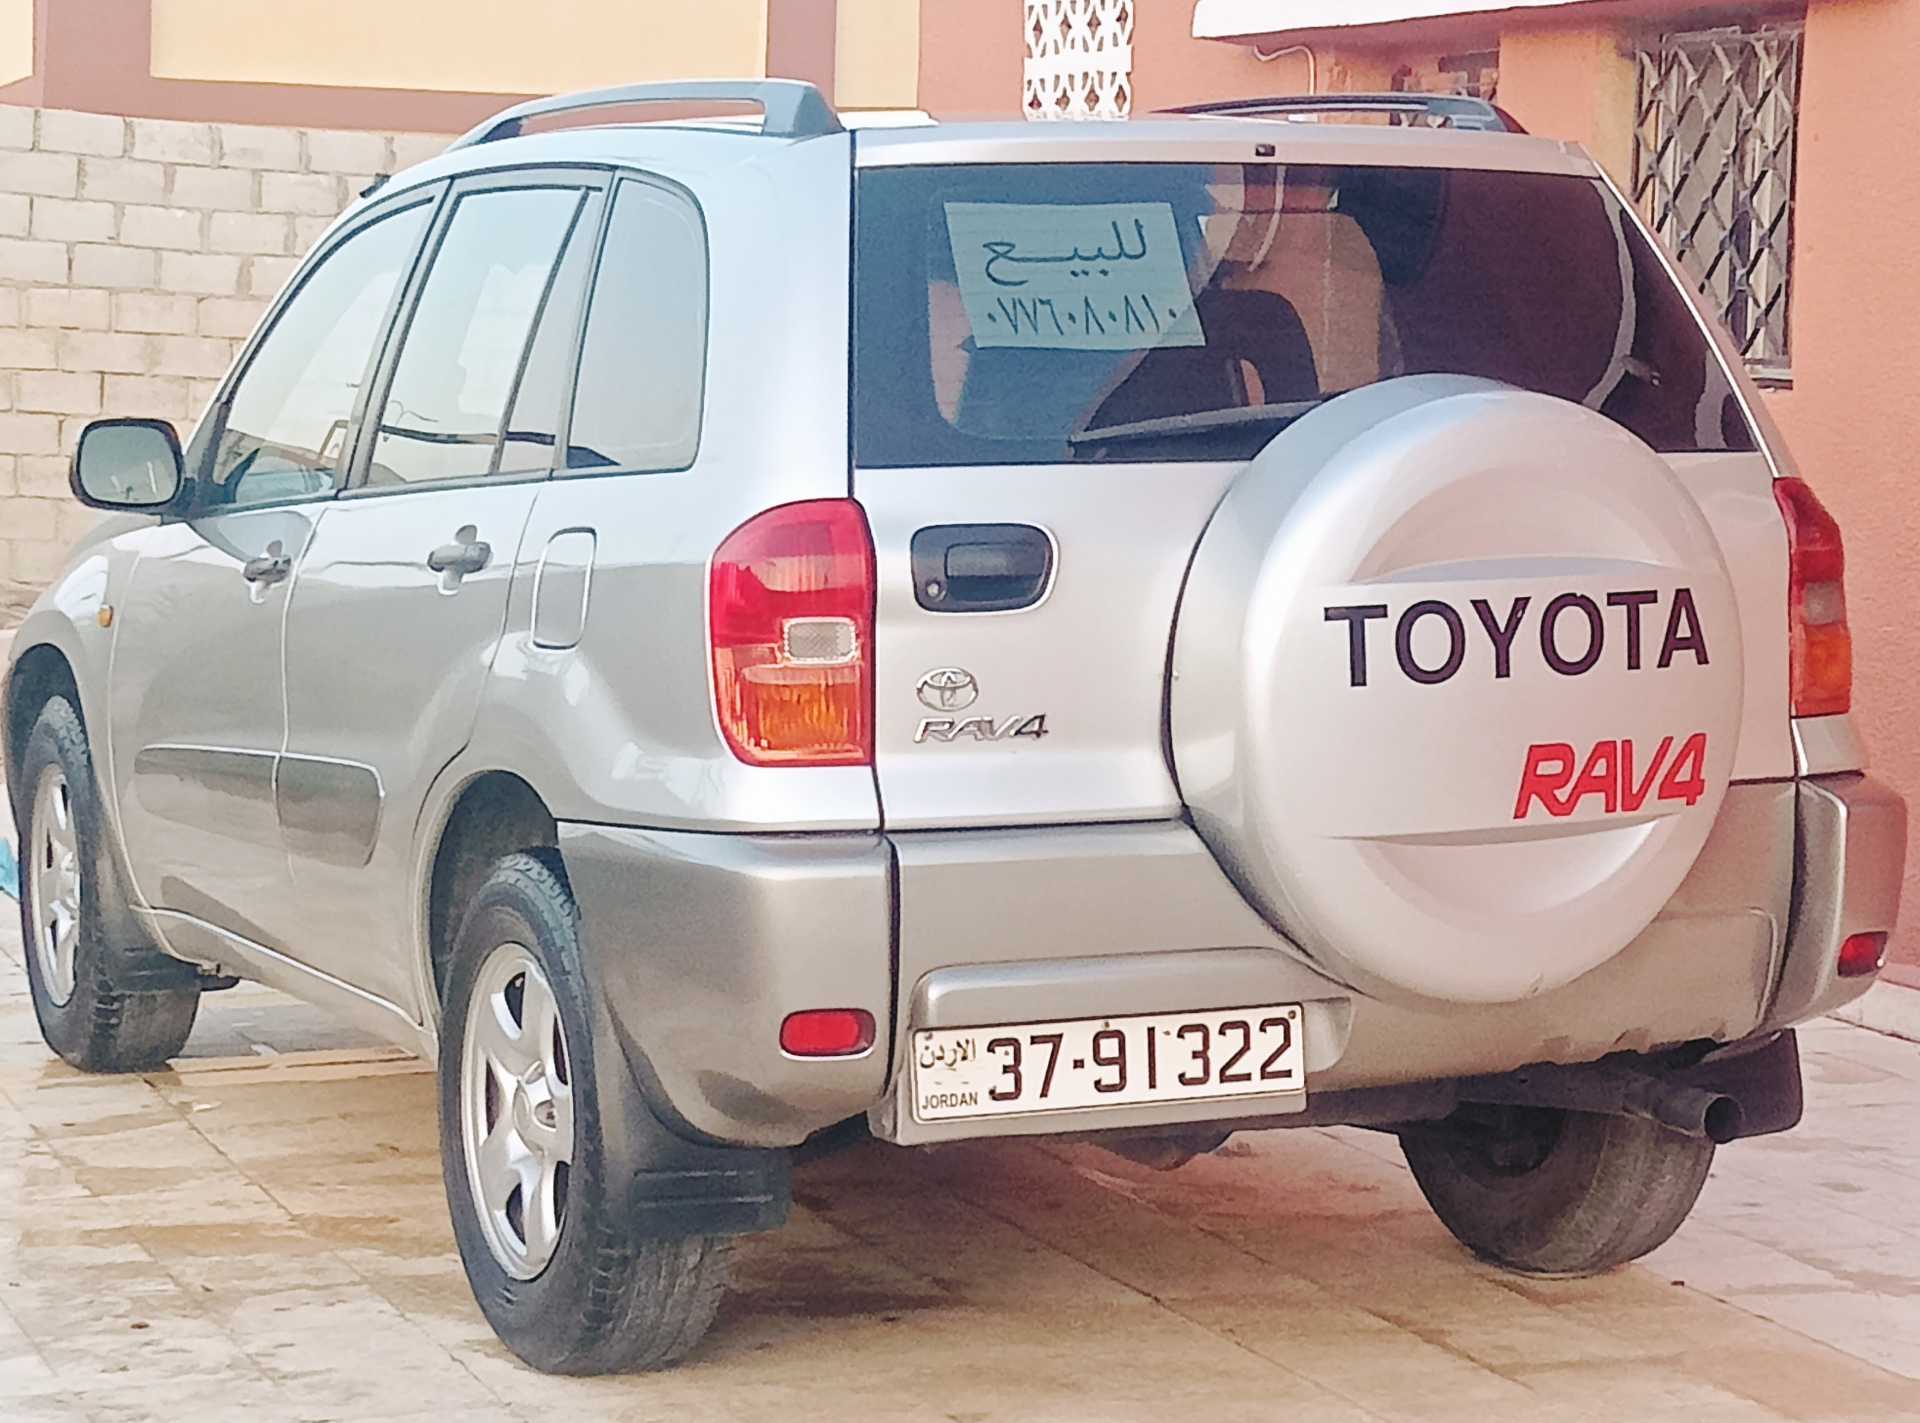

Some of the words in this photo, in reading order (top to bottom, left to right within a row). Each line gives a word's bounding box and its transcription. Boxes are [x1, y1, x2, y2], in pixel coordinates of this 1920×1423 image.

[982, 218, 1147, 286] للبيع
[1324, 588, 1710, 687] TOYOTA
[912, 713, 1049, 743] RAV4
[1513, 732, 1707, 820] RAV4
[987, 1016, 1292, 1101] 37-91322
[921, 1091, 978, 1110] JORDAN
